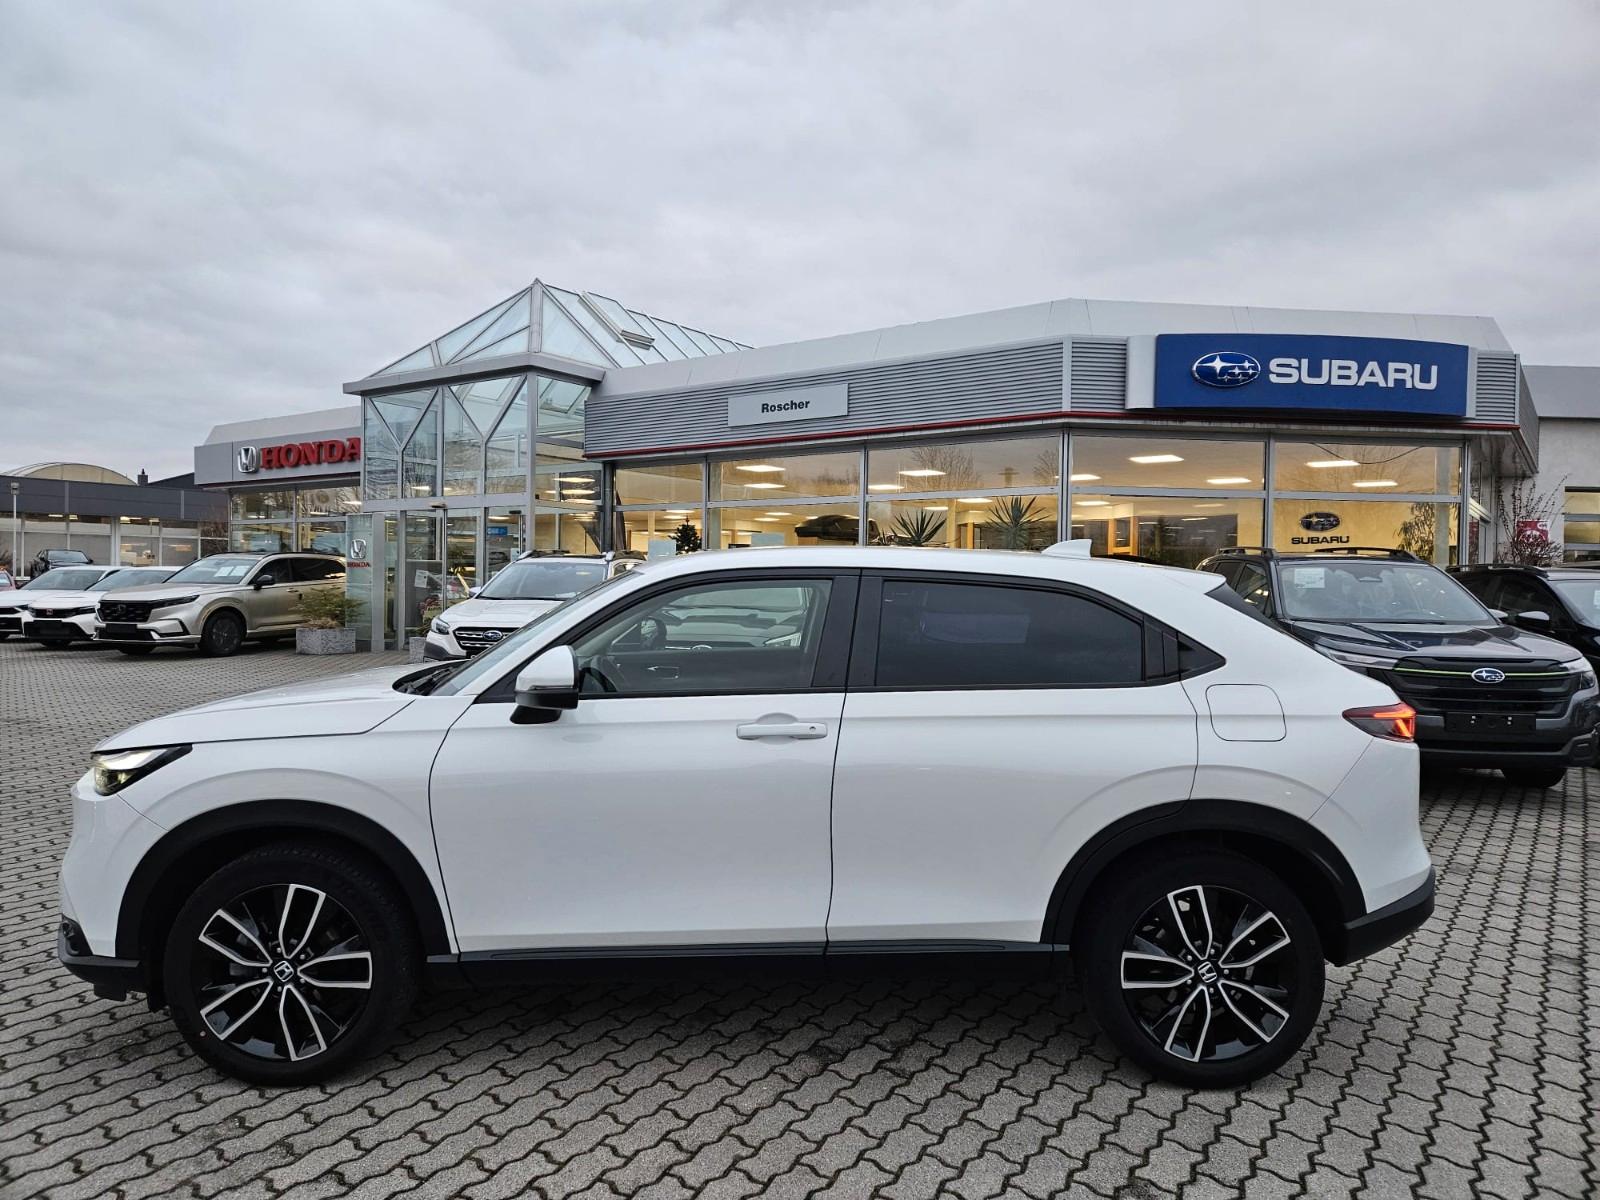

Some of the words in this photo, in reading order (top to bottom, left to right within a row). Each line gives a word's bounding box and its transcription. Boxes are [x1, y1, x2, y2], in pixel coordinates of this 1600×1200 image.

[1268, 357, 1438, 391] SUBARU
[761, 400, 810, 413] Roscher
[260, 437, 361, 470] HONDA
[1291, 536, 1350, 545] SUBARU
